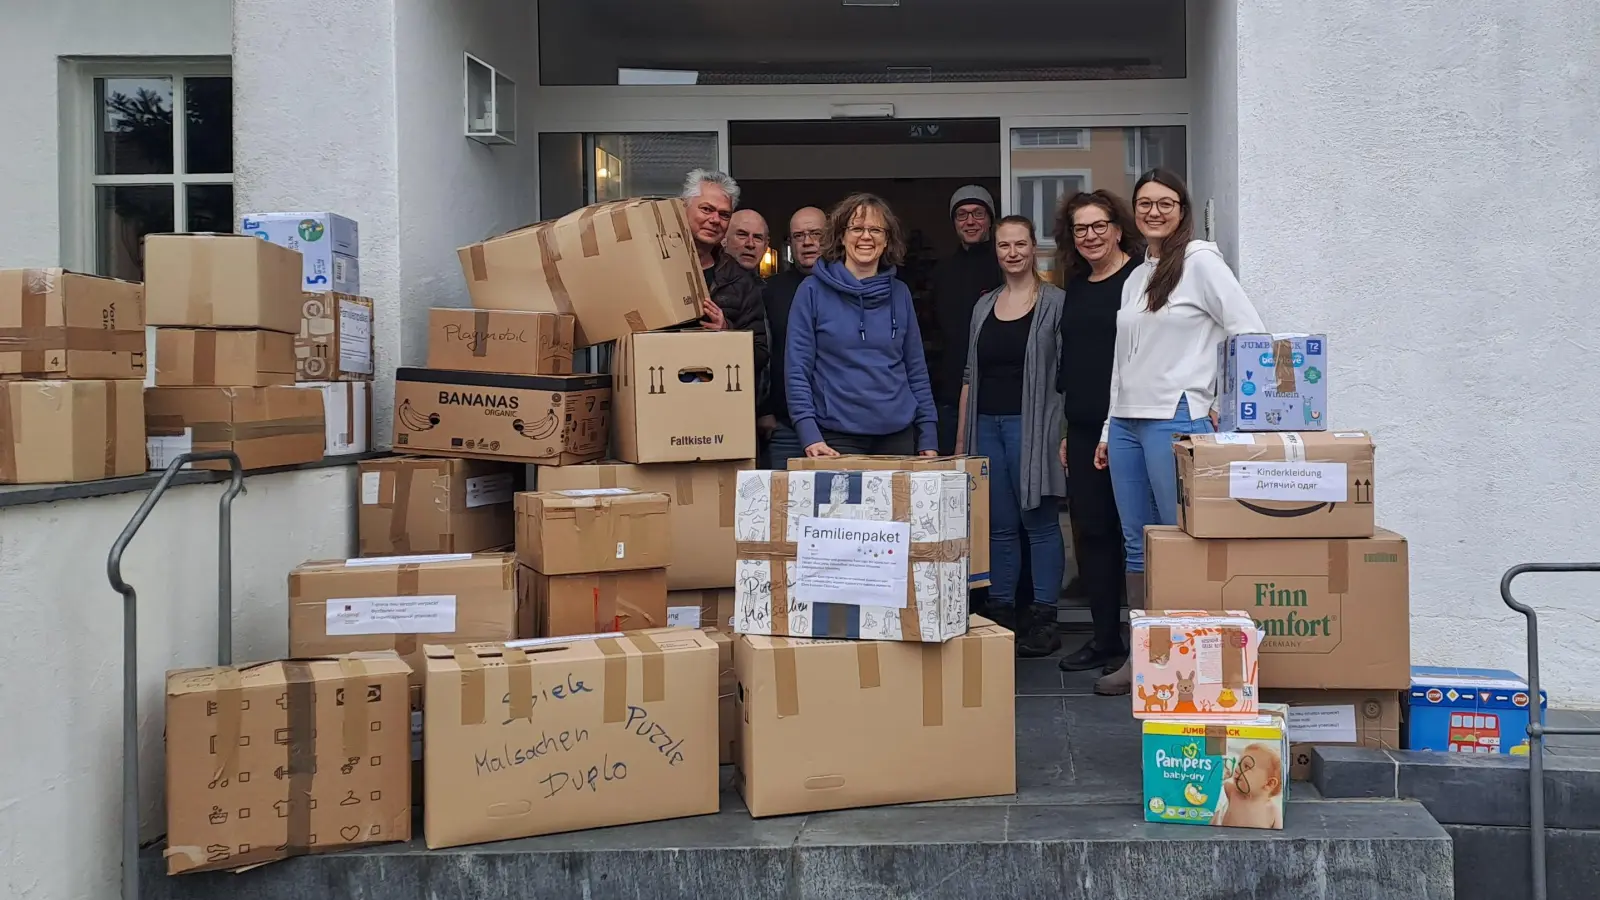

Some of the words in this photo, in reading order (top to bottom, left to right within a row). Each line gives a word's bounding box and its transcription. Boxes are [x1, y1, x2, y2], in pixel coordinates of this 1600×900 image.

[1240, 341, 1272, 349] JUMB
[1307, 342, 1319, 350] 72
[51, 356, 59, 366] 4
[438, 391, 519, 409] BANANAS
[1264, 390, 1300, 399] Windeln
[484, 409, 518, 418] ORGANIC
[1244, 403, 1253, 415] 5
[670, 435, 712, 446] Faltkiste
[714, 434, 724, 444] IV
[1256, 468, 1322, 479] Kinderkleidung
[1256, 480, 1296, 490] Дитячий
[804, 525, 900, 544] Familienpaket
[1254, 582, 1308, 607] Finn
[1252, 610, 1331, 637] omfort
[625, 705, 684, 767] Puzzle
[475, 727, 589, 776] Malsachen
[1155, 749, 1212, 772] Pampers
[539, 753, 627, 799] Duplo
[1163, 770, 1205, 781] baby-dry
